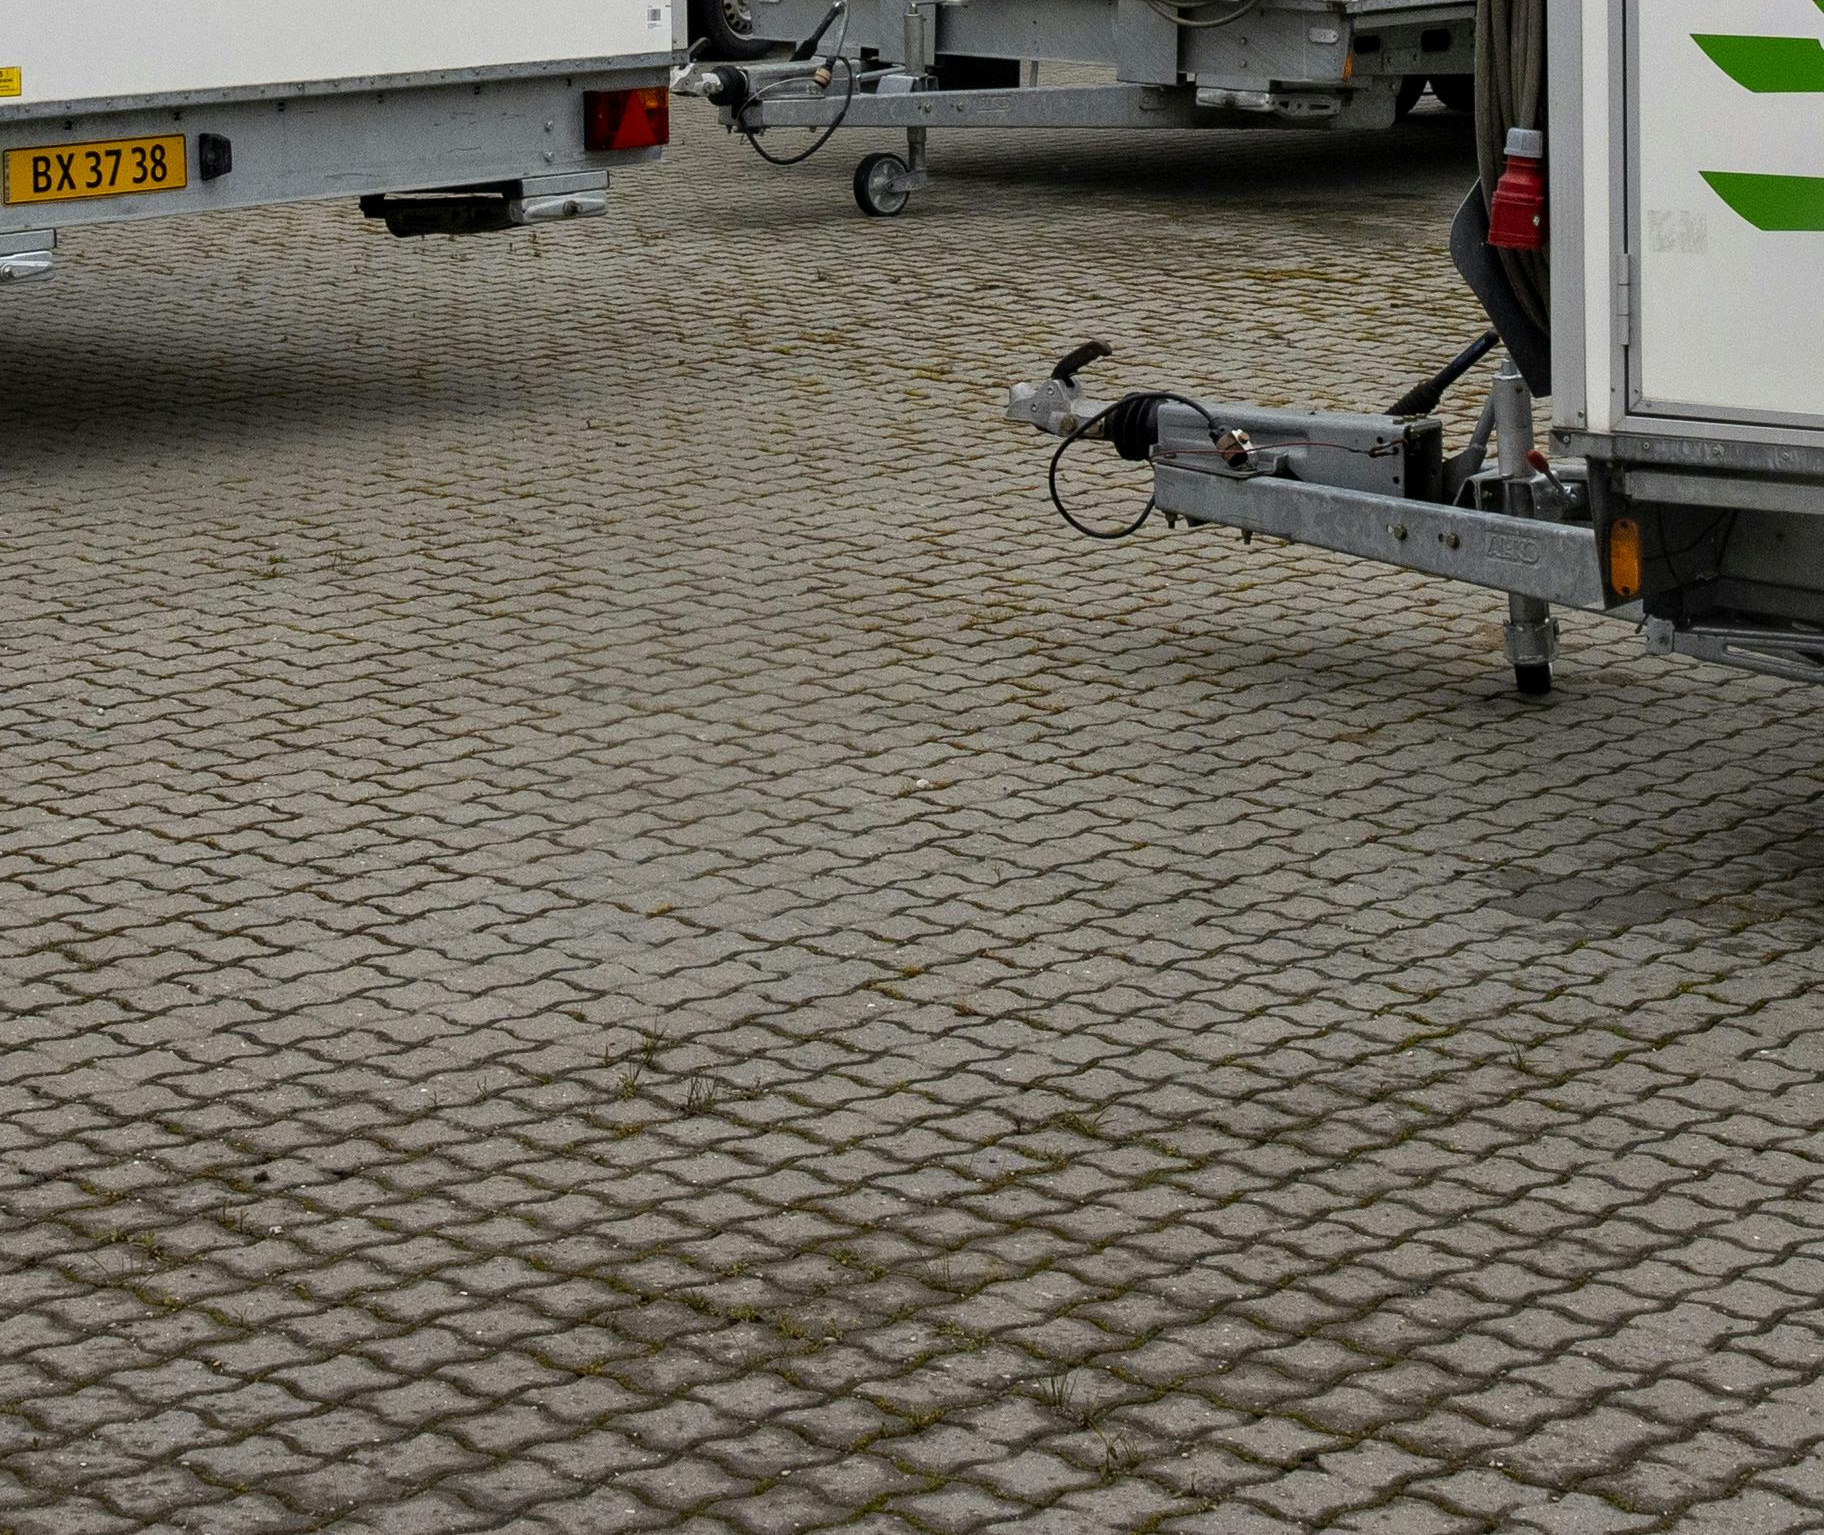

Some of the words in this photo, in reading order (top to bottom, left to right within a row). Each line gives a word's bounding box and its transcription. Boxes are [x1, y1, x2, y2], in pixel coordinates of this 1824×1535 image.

[32, 152, 76, 194] BX
[85, 148, 123, 189] 37
[131, 144, 168, 185] 38
